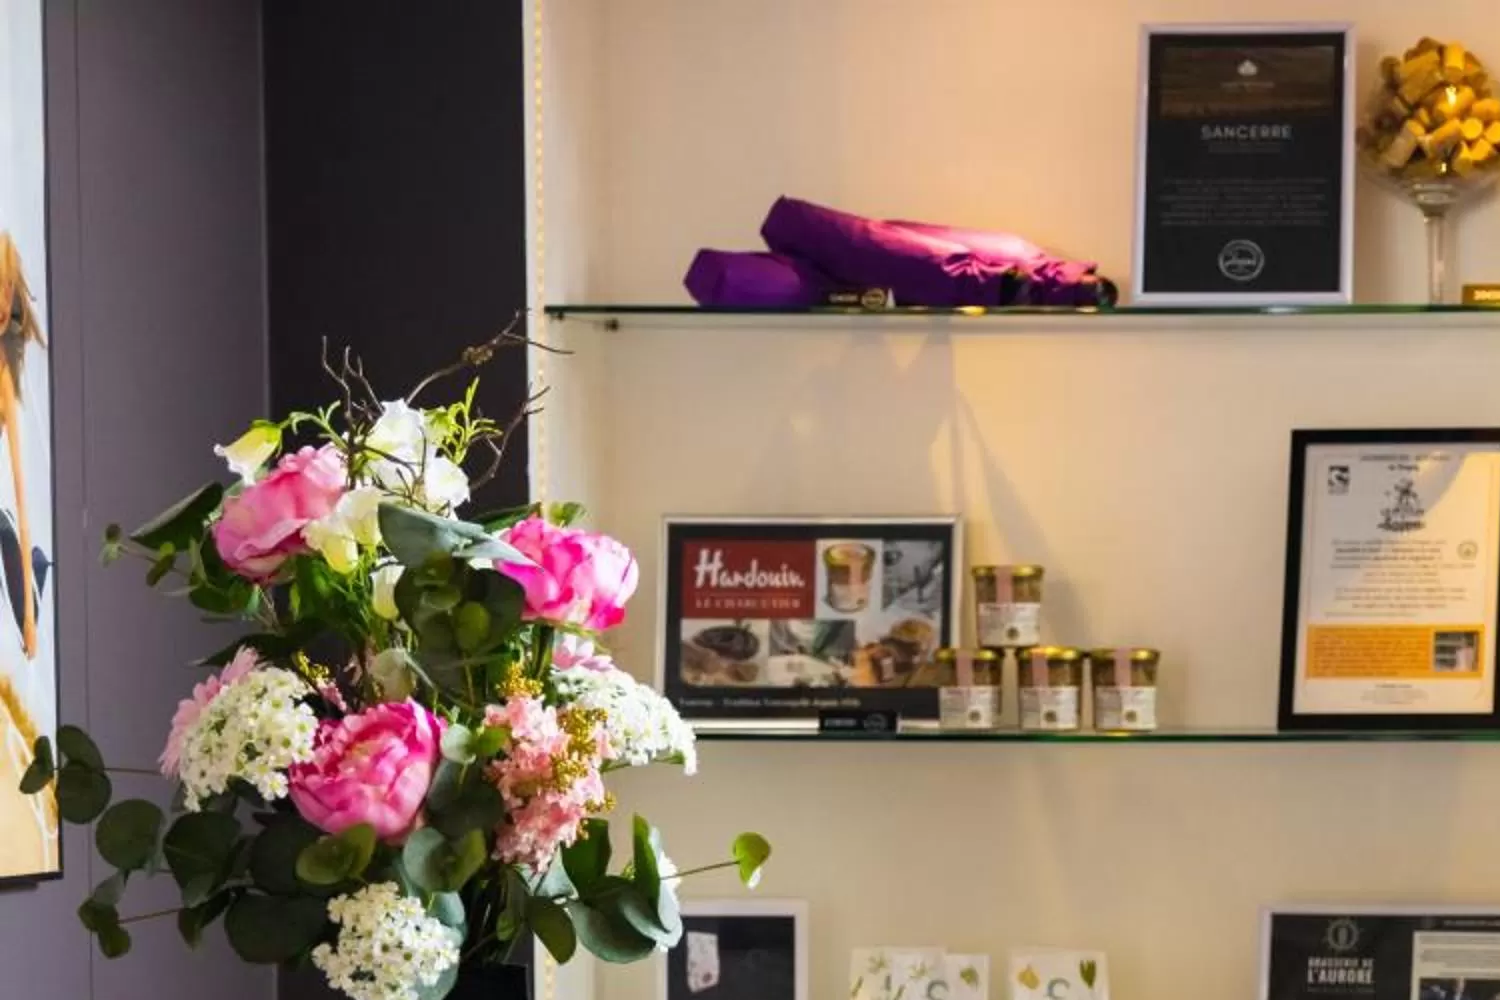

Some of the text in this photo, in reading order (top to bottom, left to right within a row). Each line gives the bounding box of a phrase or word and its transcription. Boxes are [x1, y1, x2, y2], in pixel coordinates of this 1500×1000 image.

[1200, 124, 1293, 141] SANCERRE
[694, 548, 805, 588] Hardouin
[1307, 968, 1373, 985] L'AURORE
